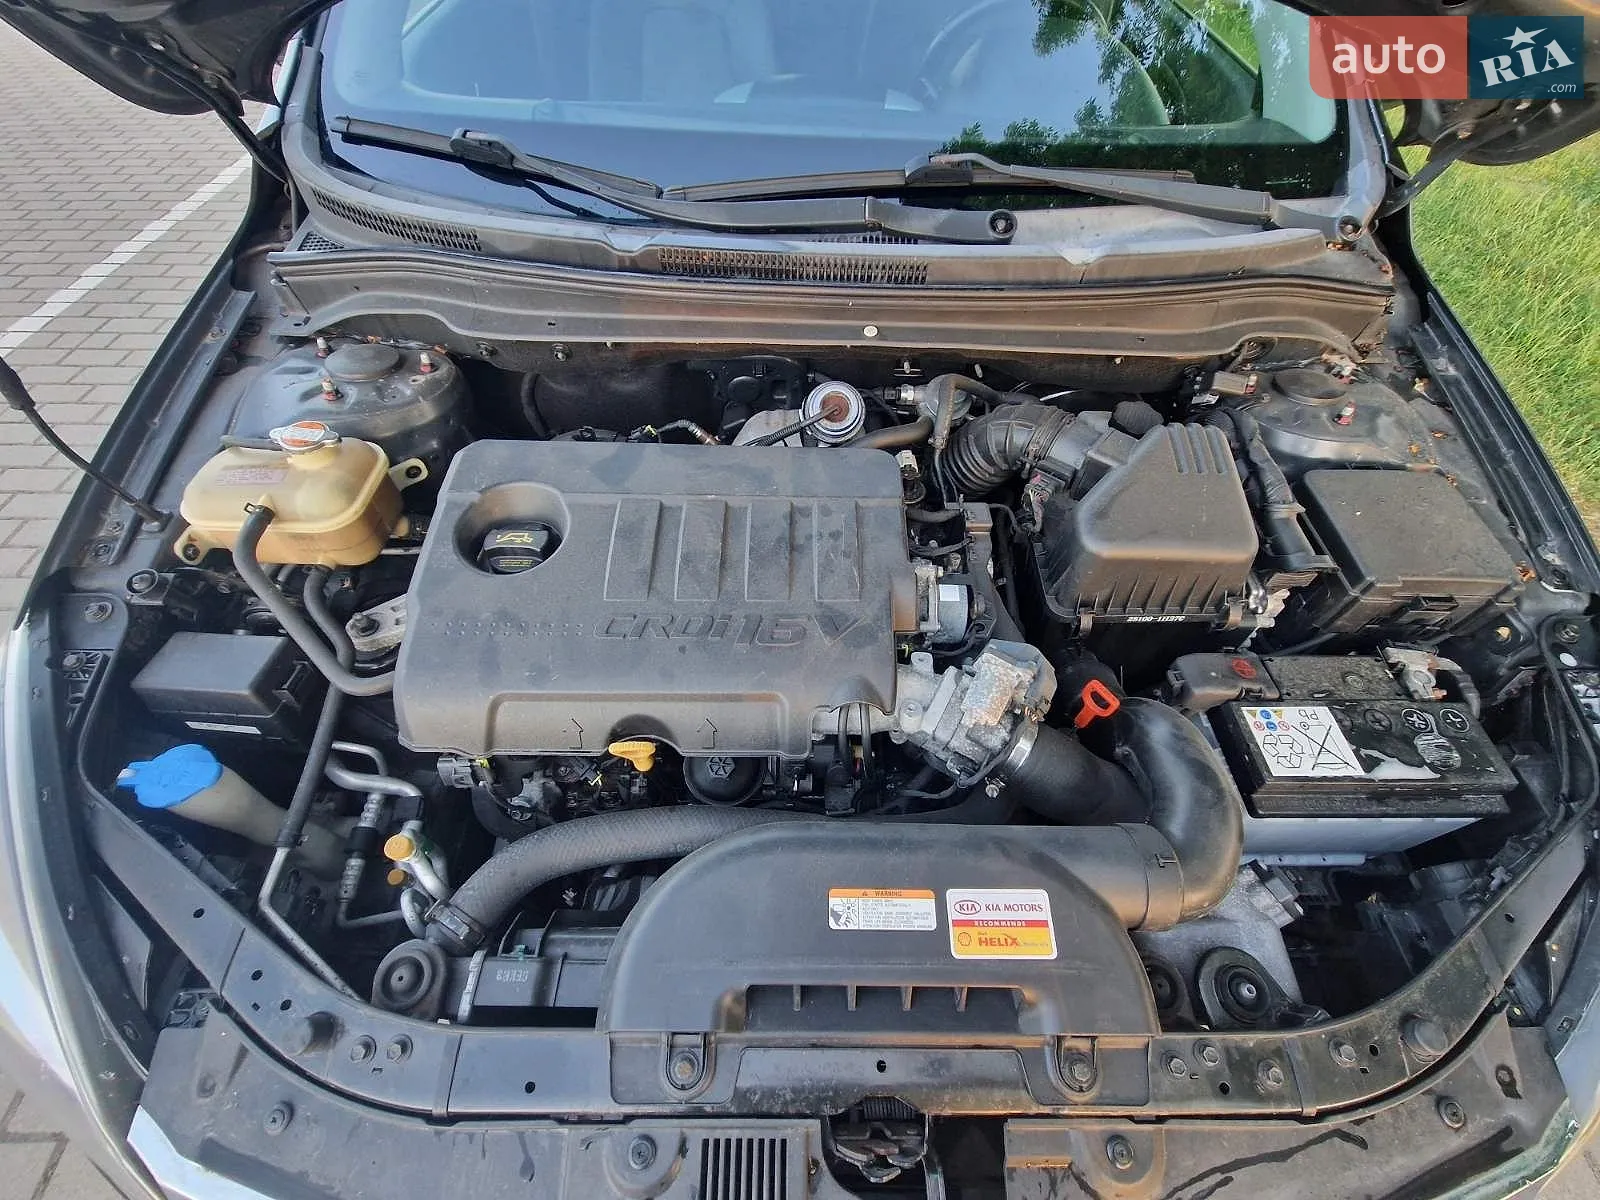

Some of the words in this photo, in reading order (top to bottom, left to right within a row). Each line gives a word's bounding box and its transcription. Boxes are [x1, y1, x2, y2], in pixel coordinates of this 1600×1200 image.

[733, 613, 868, 648] 16V
[959, 904, 977, 912] KIA
[984, 904, 1001, 912] KIA
[1003, 904, 1044, 912] MOTORS
[978, 935, 1020, 947] HELIX
